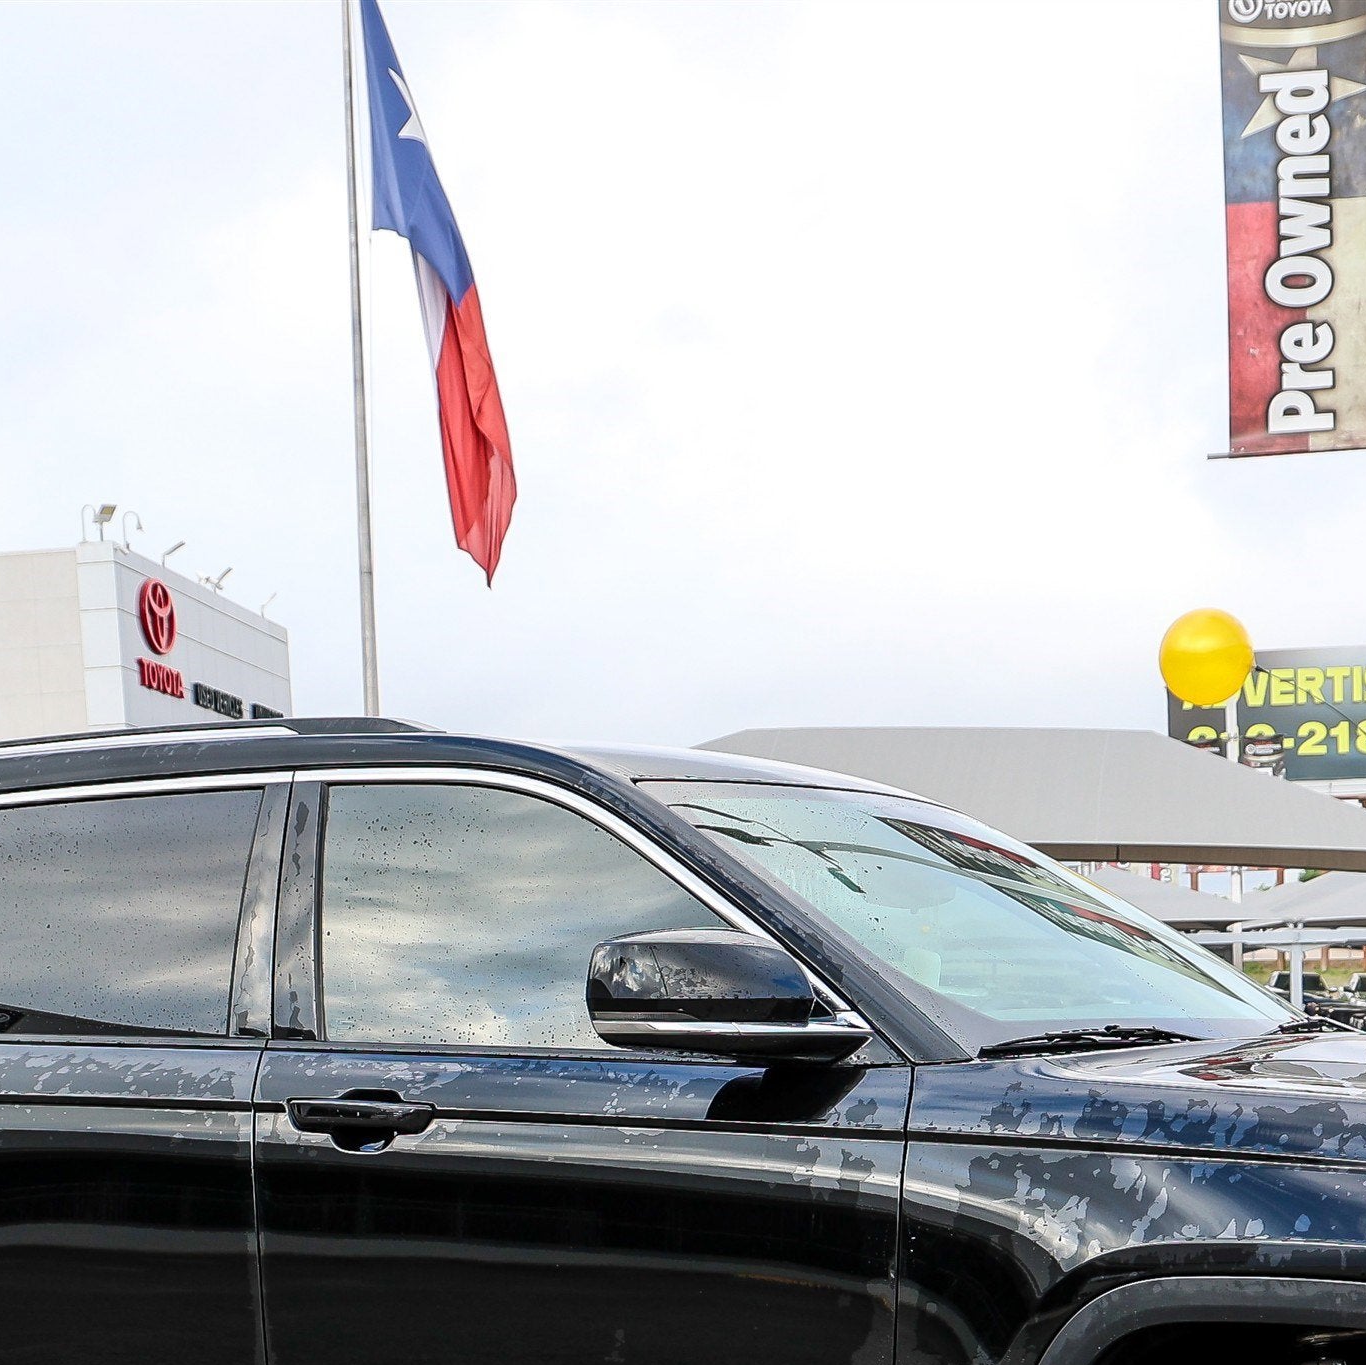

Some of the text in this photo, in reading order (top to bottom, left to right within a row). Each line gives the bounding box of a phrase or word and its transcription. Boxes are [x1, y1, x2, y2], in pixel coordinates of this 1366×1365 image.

[1264, 0, 1333, 20] TOYOTA
[1259, 69, 1334, 308] Owned
[1267, 321, 1335, 434] Pre
[138, 657, 184, 699] TOYOTA
